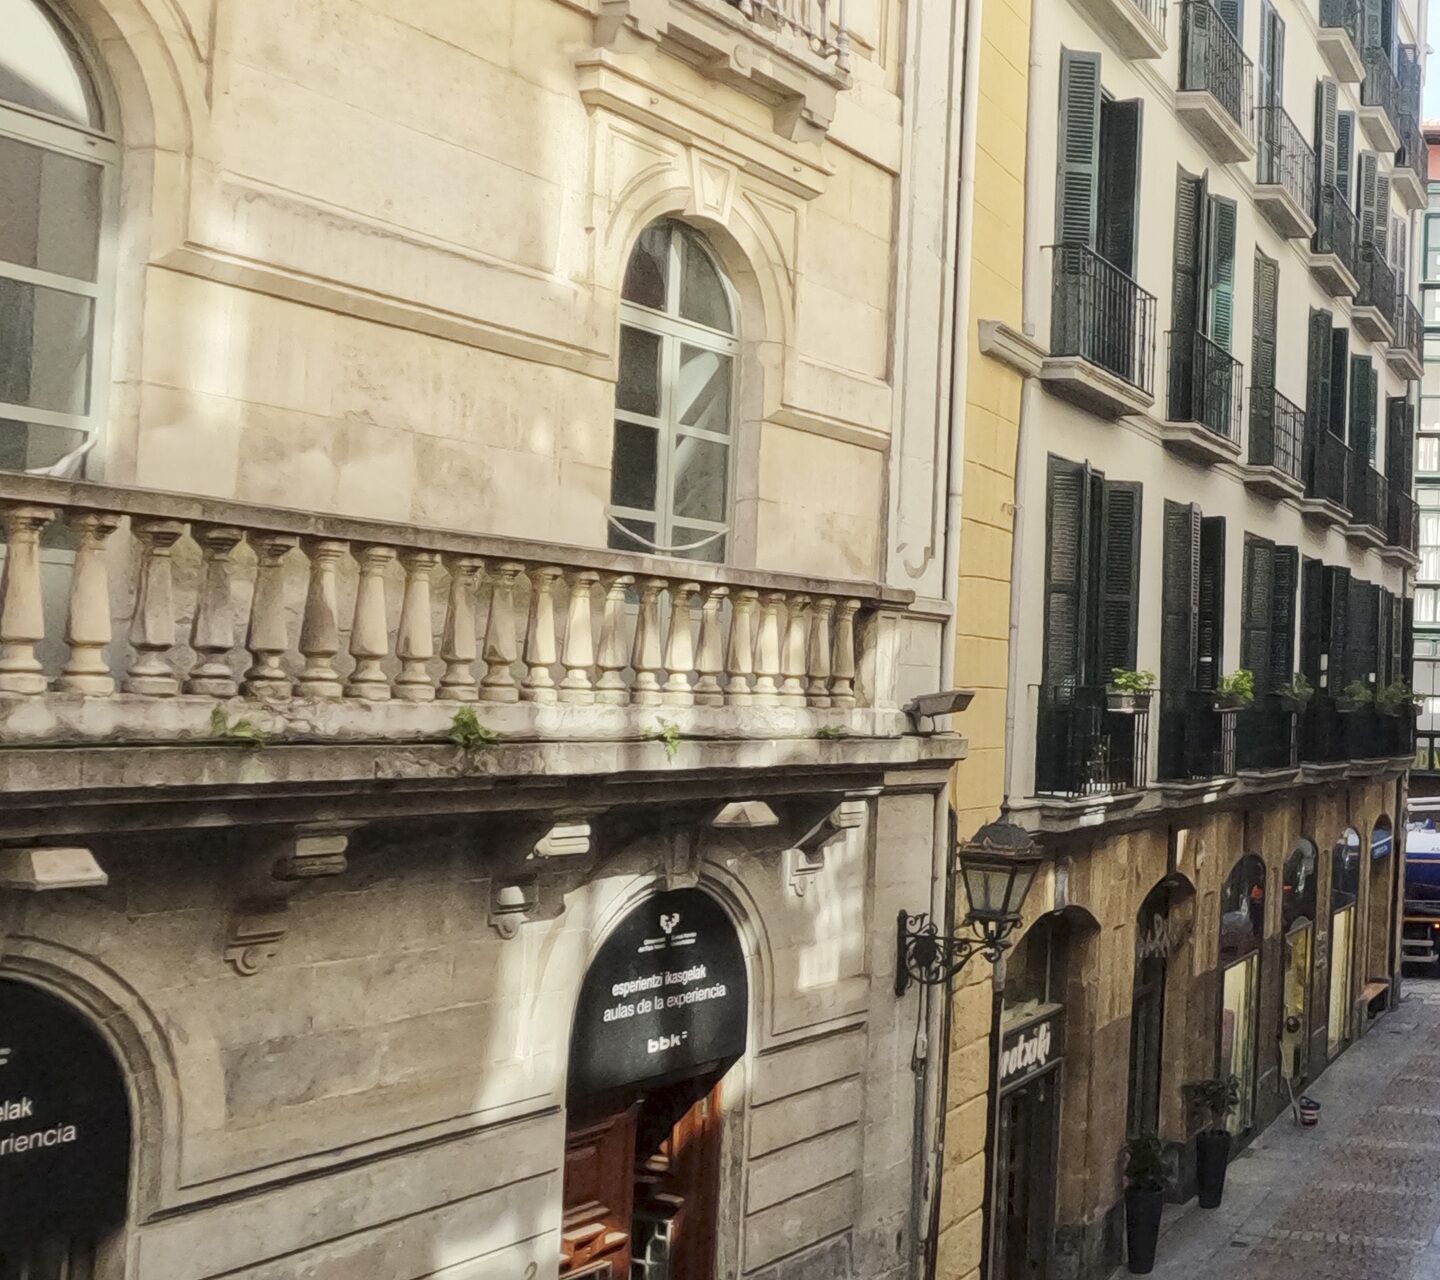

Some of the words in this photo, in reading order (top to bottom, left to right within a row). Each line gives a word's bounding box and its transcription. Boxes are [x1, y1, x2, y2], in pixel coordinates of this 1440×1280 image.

[611, 973, 663, 998] esperientzi
[664, 964, 707, 985] ikasgelak
[603, 1003, 635, 1022] aulas
[636, 998, 653, 1015] de
[654, 996, 664, 1010] la
[666, 983, 727, 1009] experiencia
[647, 1033, 681, 1054] bbk
